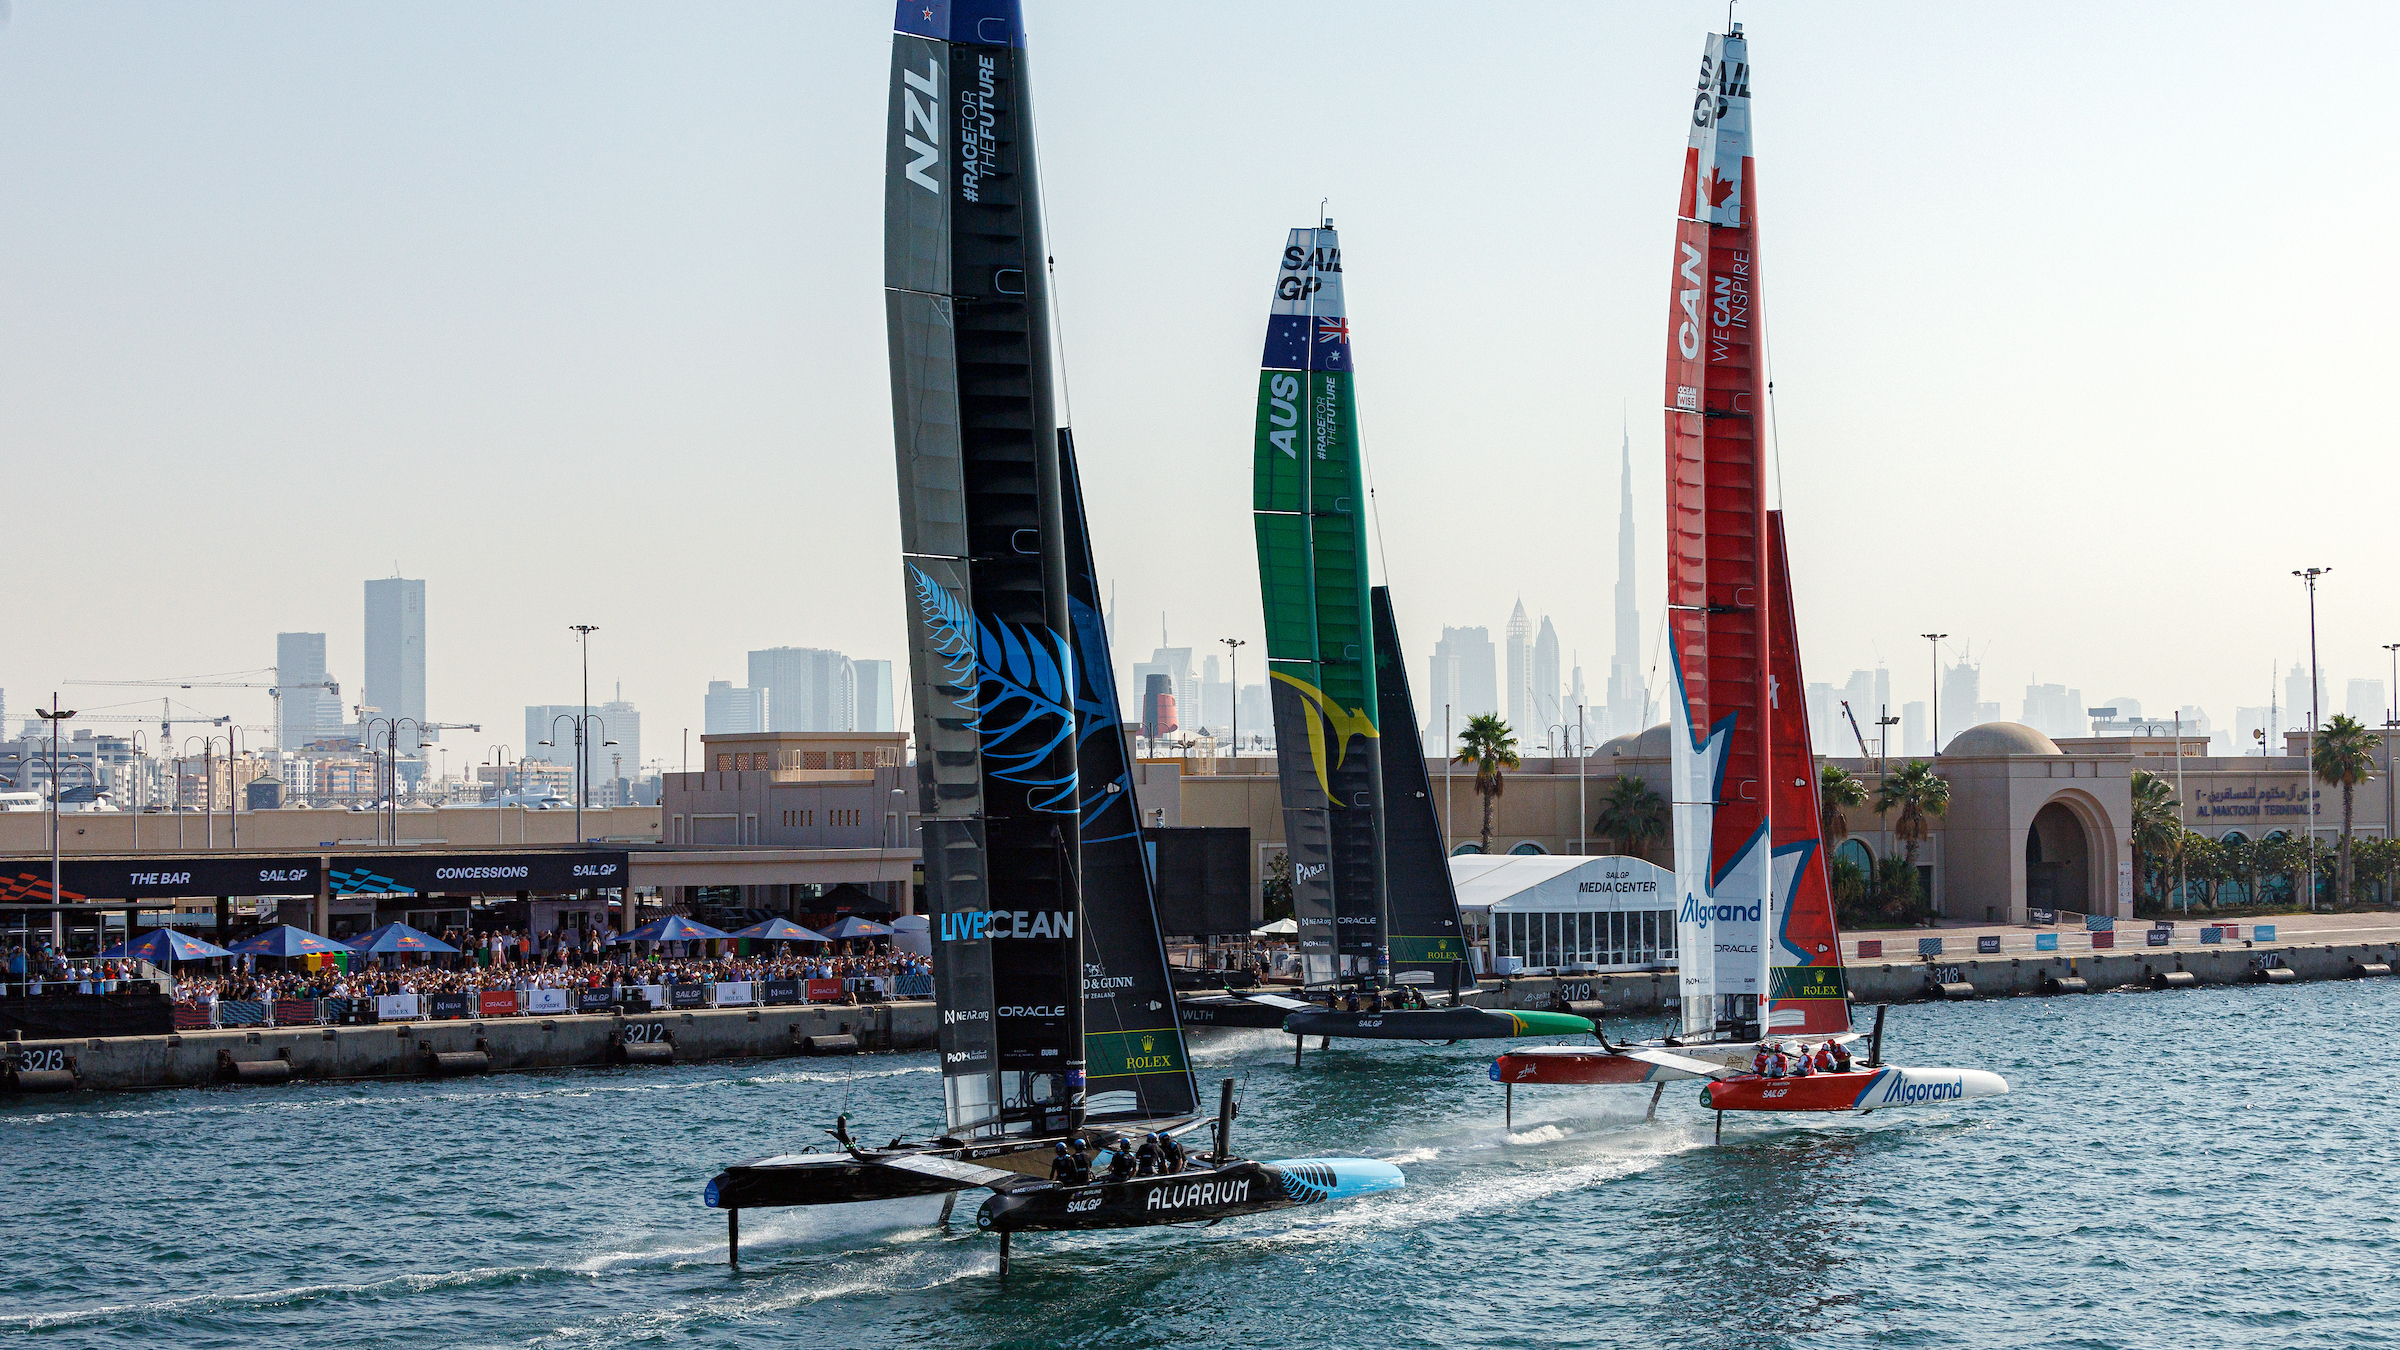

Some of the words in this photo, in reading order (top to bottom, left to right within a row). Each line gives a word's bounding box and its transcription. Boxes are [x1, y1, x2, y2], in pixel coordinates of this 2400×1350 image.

[1698, 54, 1751, 99] SAIL
[1693, 92, 1729, 129] GP
[904, 58, 939, 194] NZL
[1281, 246, 1343, 273] SAIL
[1278, 276, 1322, 301] GP
[1731, 251, 1750, 329] INSPIRE
[1678, 241, 1702, 360] CAN
[1678, 386, 1697, 396] OCEAN
[1678, 396, 1696, 407] WISE
[1269, 373, 1299, 460] AUS
[2197, 806, 2210, 817] AL
[130, 873, 159, 885] THE
[160, 872, 191, 884] BAR
[436, 866, 529, 879] CONCESSIONS
[1579, 882, 1613, 893] MEDIA
[1615, 881, 1657, 893] CENTER
[1679, 892, 1762, 929] Algorand
[1337, 917, 1377, 925] ORACLE
[1427, 951, 1458, 960] ROLEX
[1714, 944, 1758, 953] ORACLE
[2257, 953, 2279, 970] 31/7
[1934, 967, 1959, 984] 31/8
[1560, 983, 1590, 1001] 31/9
[1803, 986, 1838, 995] ROLEX
[485, 1000, 513, 1008] ORACLE
[998, 1005, 1066, 1017] ORACLE
[956, 1011, 989, 1022] NEAR.org
[1183, 1010, 1214, 1020] WLTH
[624, 1023, 664, 1044] 32/2
[20, 1049, 64, 1072] 32/3
[1126, 1055, 1171, 1069] ROLEX
[1882, 1071, 1963, 1106] Algorand
